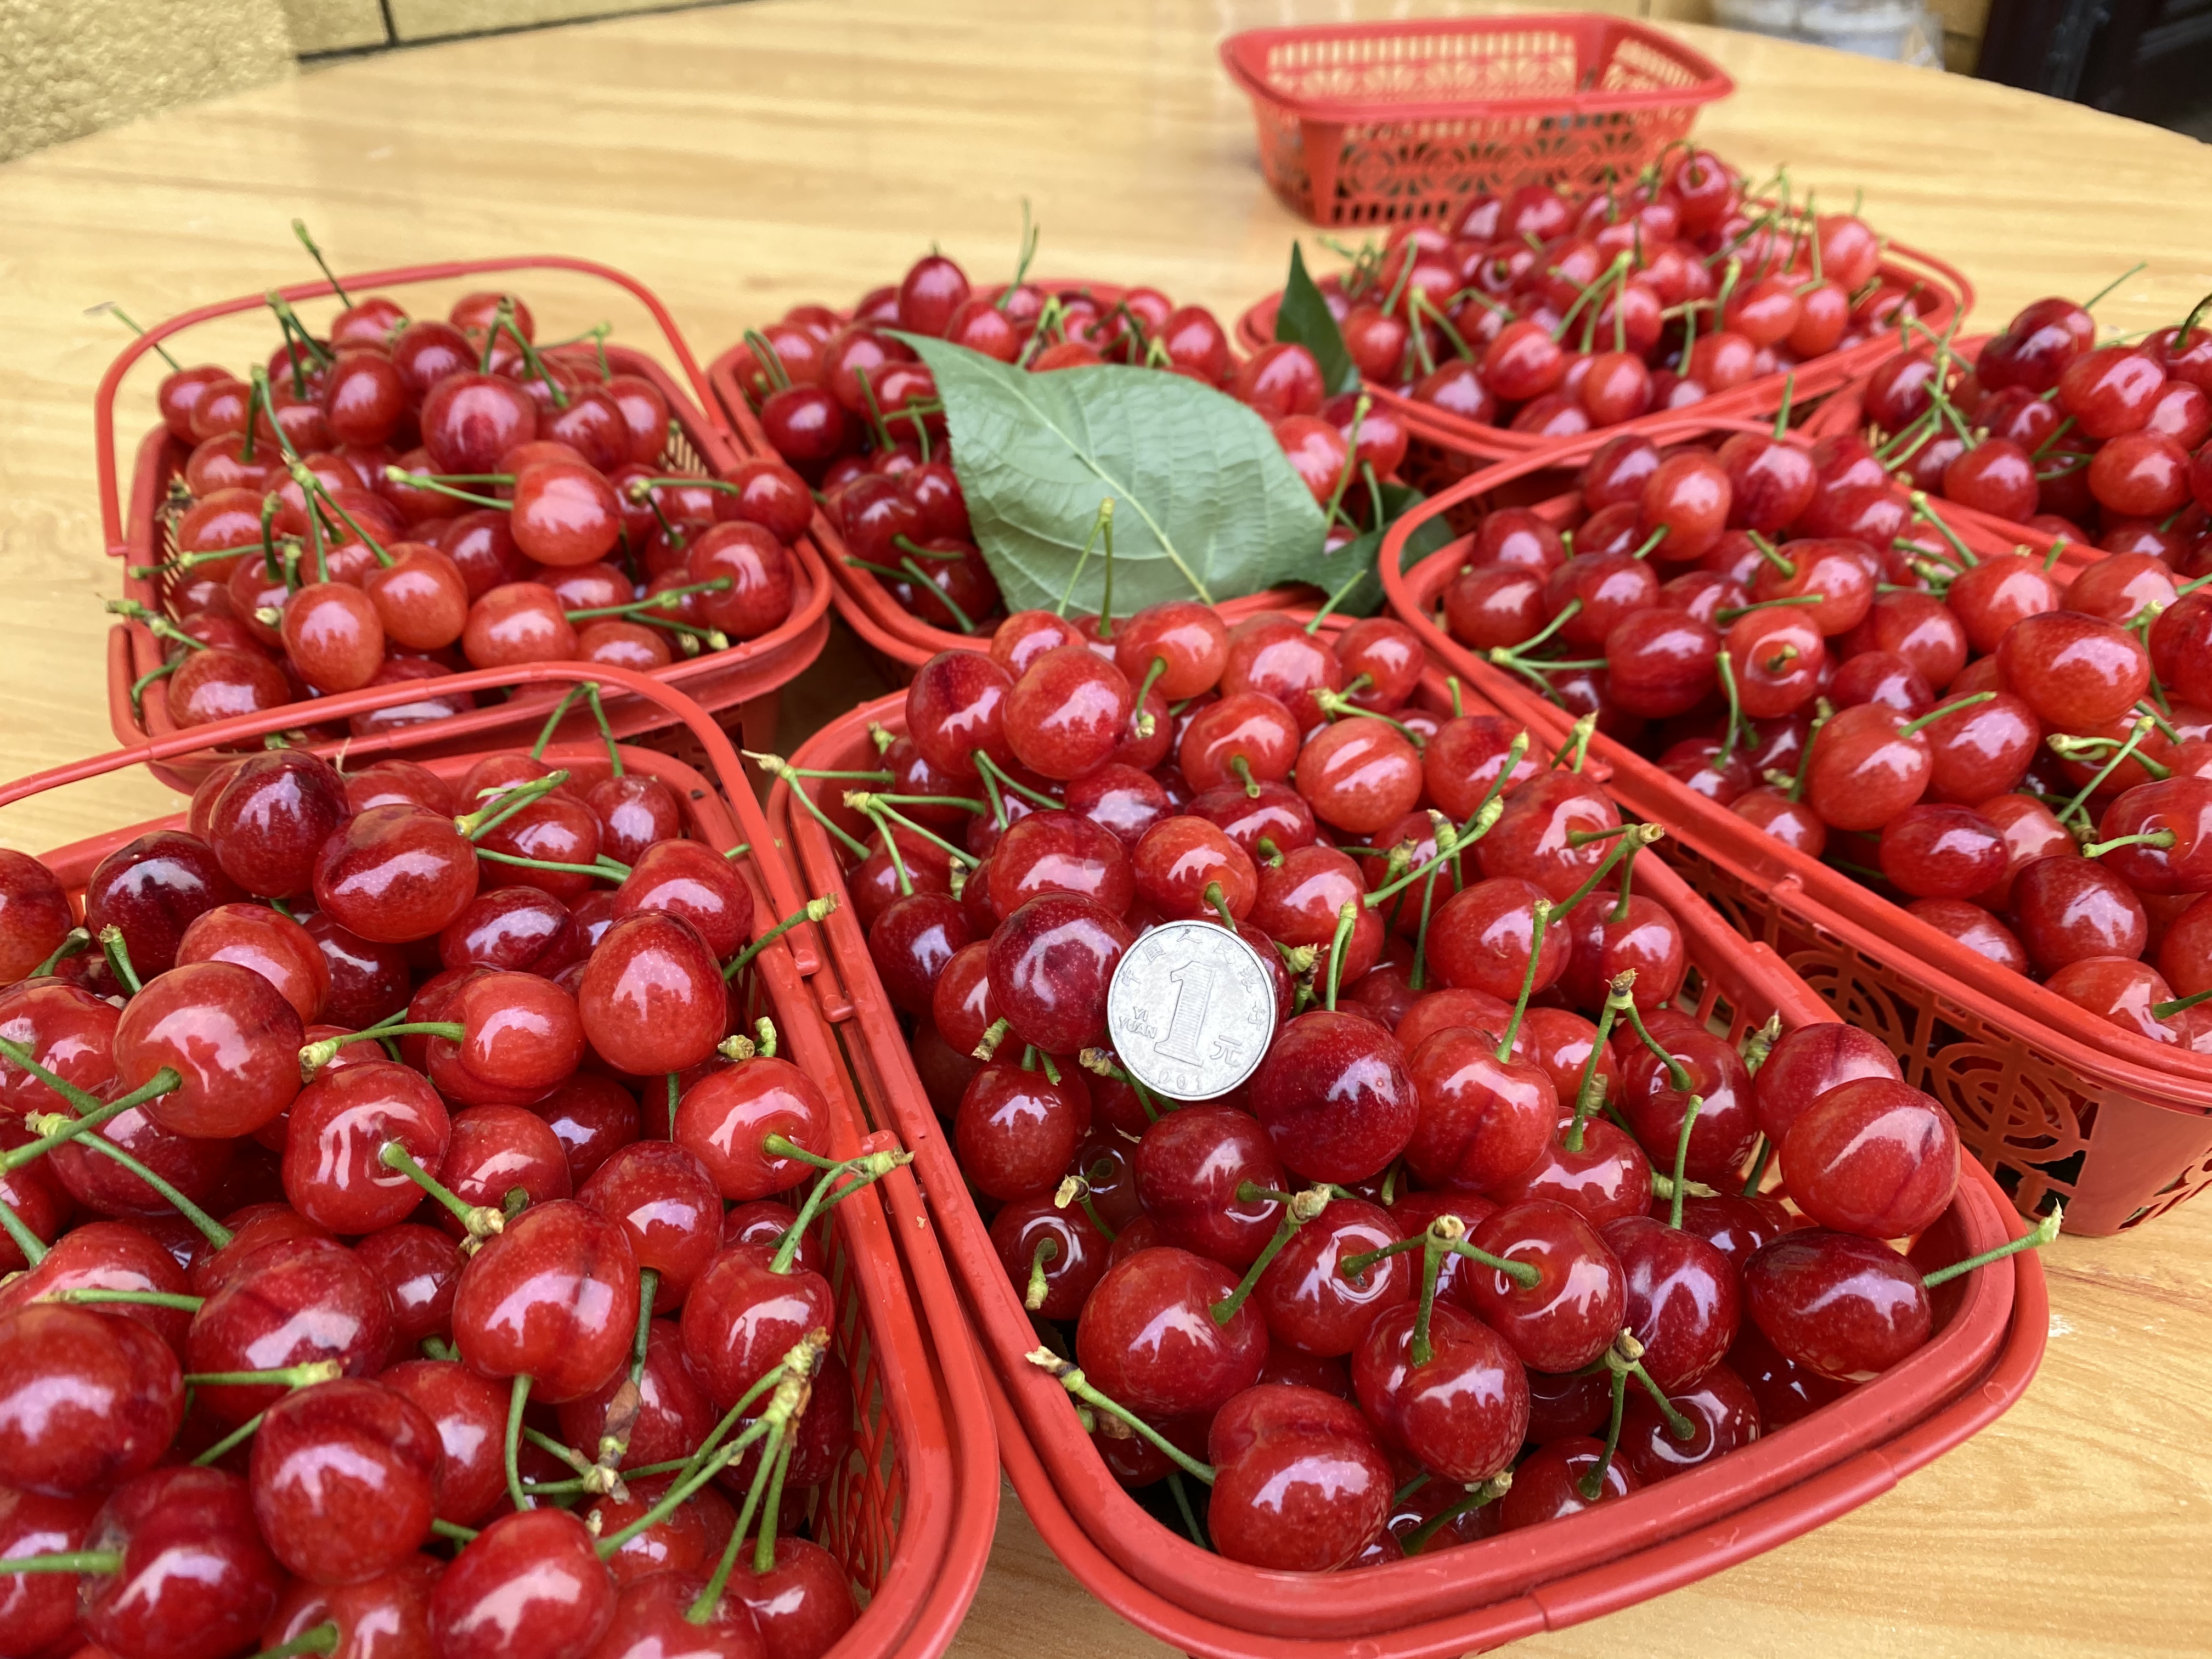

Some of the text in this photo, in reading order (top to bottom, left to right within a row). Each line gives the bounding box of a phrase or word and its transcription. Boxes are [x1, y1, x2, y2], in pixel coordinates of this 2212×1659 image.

[1133, 1006, 1149, 1022] YI
[1153, 960, 1243, 1067] 1 元
[1119, 1015, 1158, 1039] YUAN
